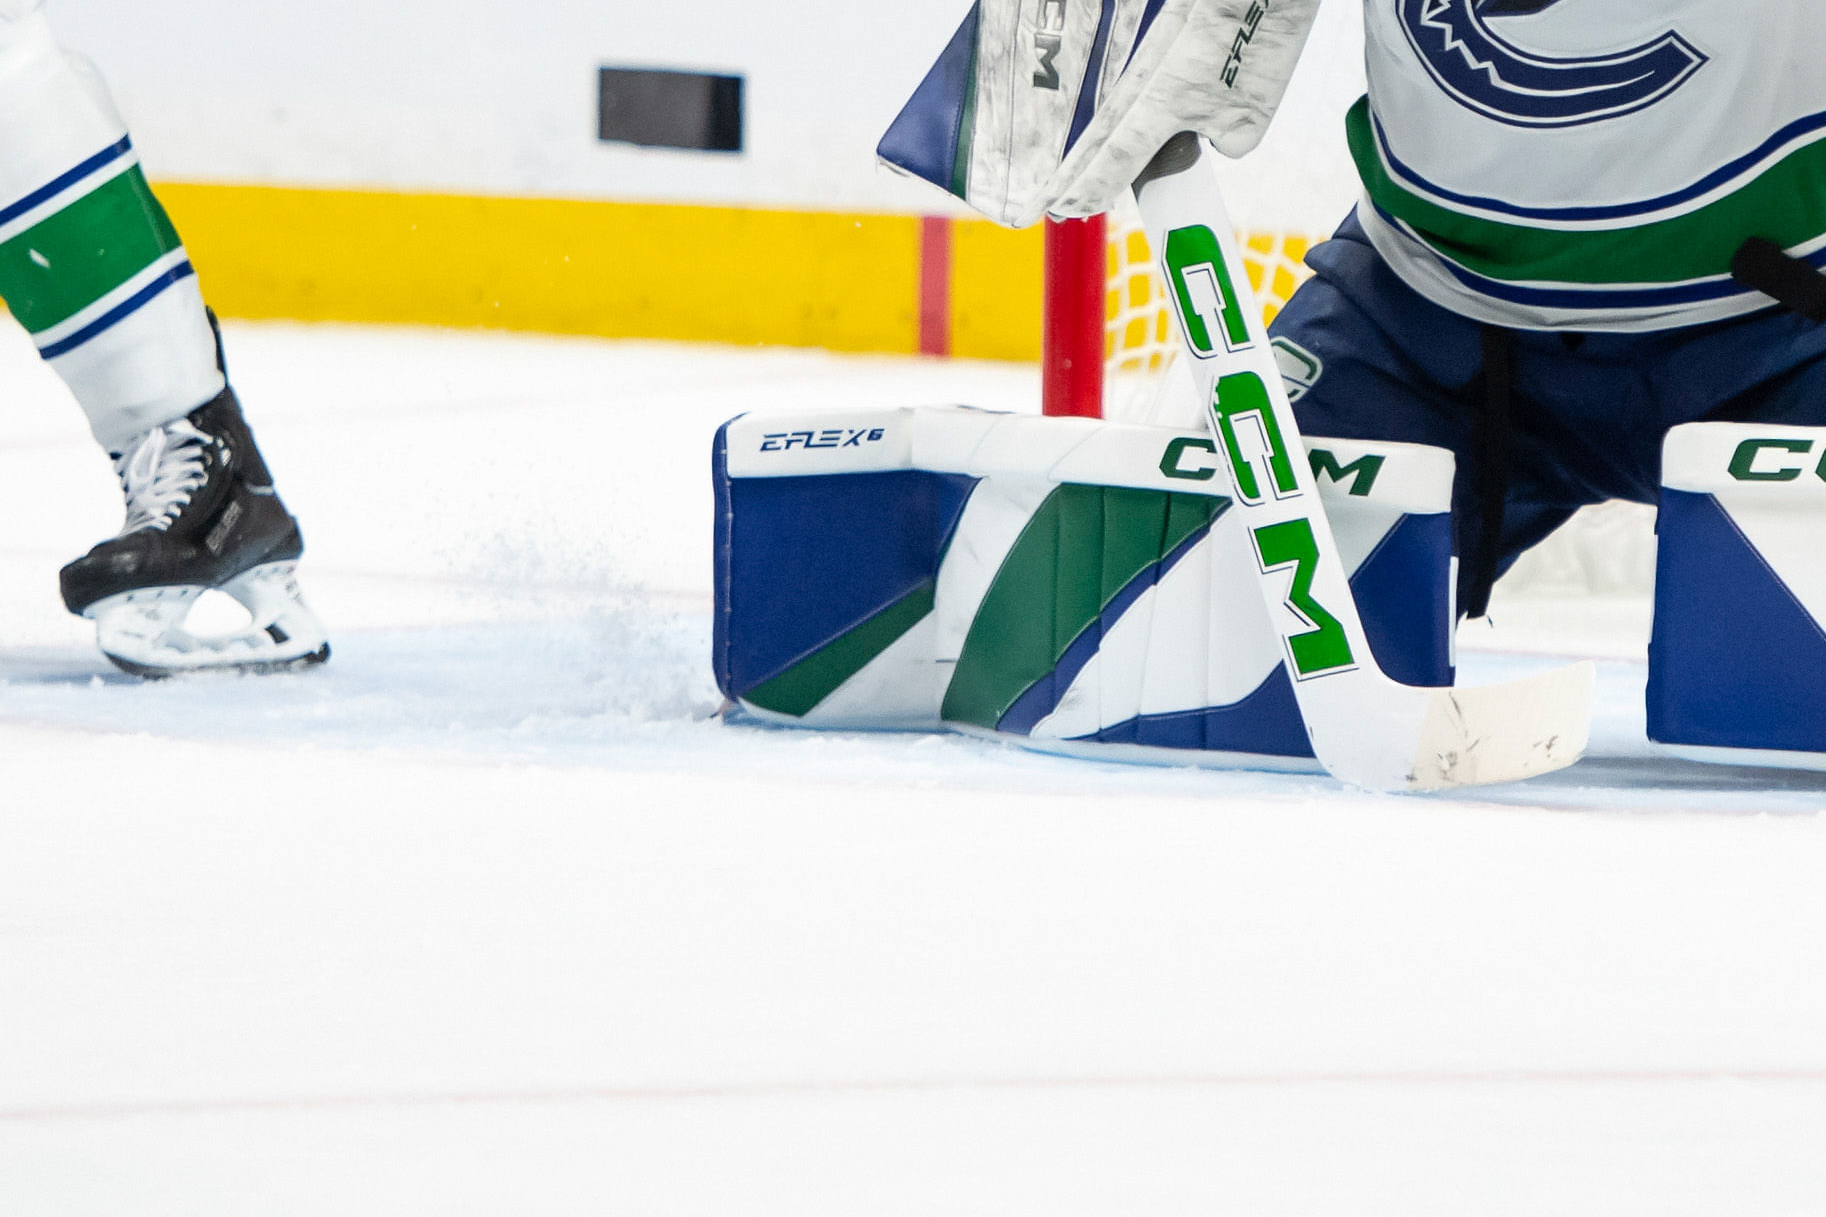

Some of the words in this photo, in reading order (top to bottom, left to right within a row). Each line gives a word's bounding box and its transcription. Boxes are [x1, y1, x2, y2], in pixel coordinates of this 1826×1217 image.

[760, 428, 886, 452] EFLEX6
[1159, 436, 1387, 497] CM
[1161, 223, 1360, 683] CCM
